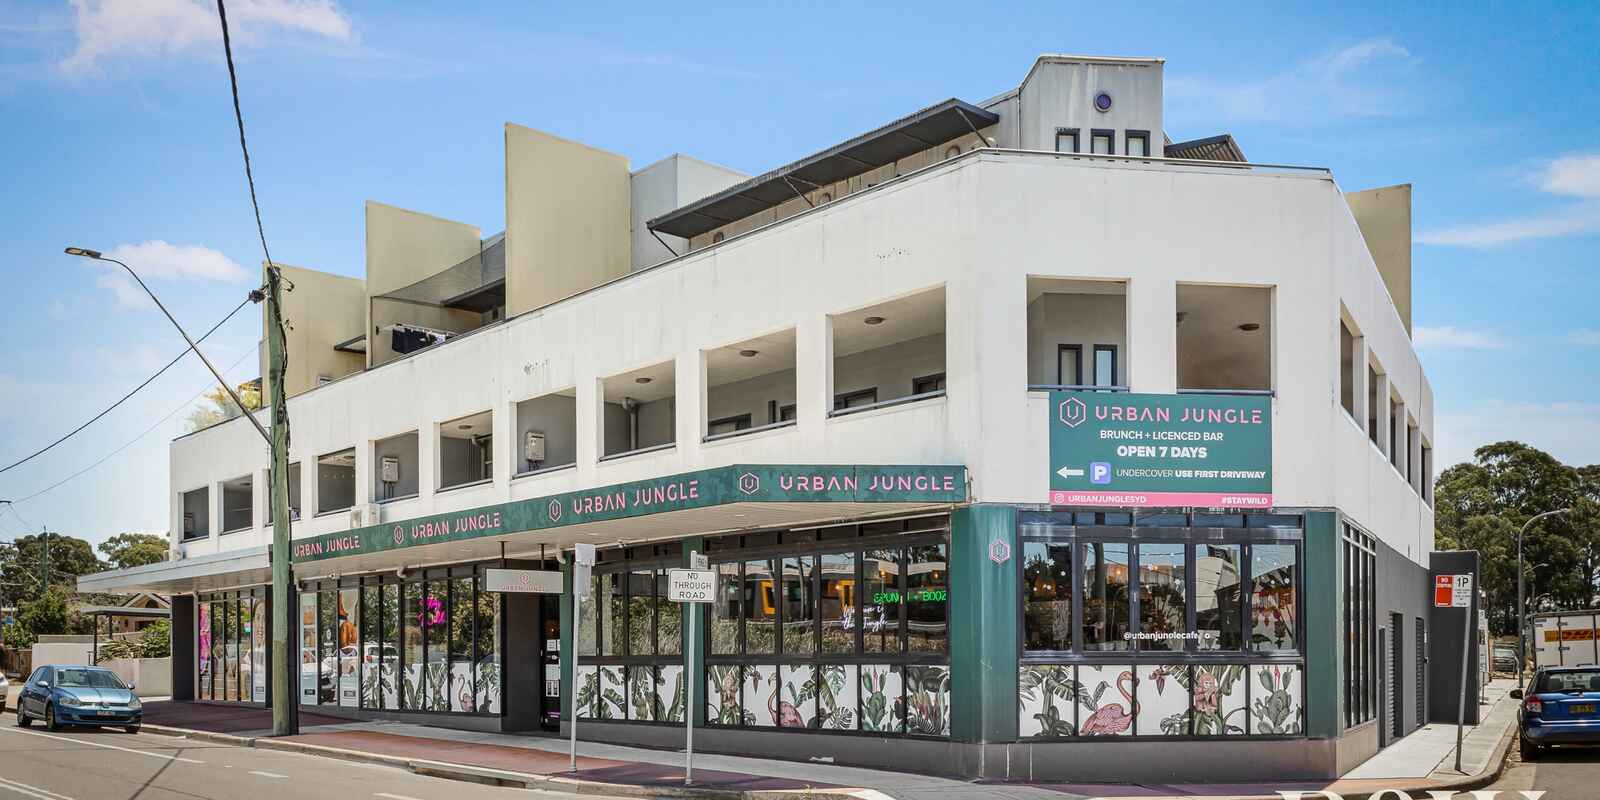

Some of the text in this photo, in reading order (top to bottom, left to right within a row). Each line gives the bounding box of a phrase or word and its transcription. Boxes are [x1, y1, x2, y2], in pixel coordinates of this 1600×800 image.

[1095, 406, 1170, 422] URBAN
[1180, 408, 1263, 424] JUNGLE
[1100, 430, 1143, 440] BRUNCH
[1152, 431, 1201, 441] LICENCED
[1203, 432, 1224, 441] BAR
[1117, 445, 1208, 458] OPEN 7 DAYS
[1116, 469, 1173, 477] UNDERCOVER
[1175, 470, 1193, 478] USE
[1194, 470, 1218, 478] FIRST
[1220, 470, 1266, 479] DRIVEWAY
[780, 476, 858, 490] URBAN
[869, 476, 955, 491] JUNGLE
[573, 492, 626, 514] URBAN
[633, 480, 699, 507] JUNGLE
[1068, 495, 1268, 505] URBANJUNGLESYD #STAYWILD
[412, 521, 449, 539] URBAN
[455, 512, 501, 532] JUNGLE
[294, 536, 360, 557] URBAN JUNGLE
[674, 581, 712, 590] THROUGH
[1456, 577, 1469, 587] 1P
[679, 592, 706, 600] ROAD
